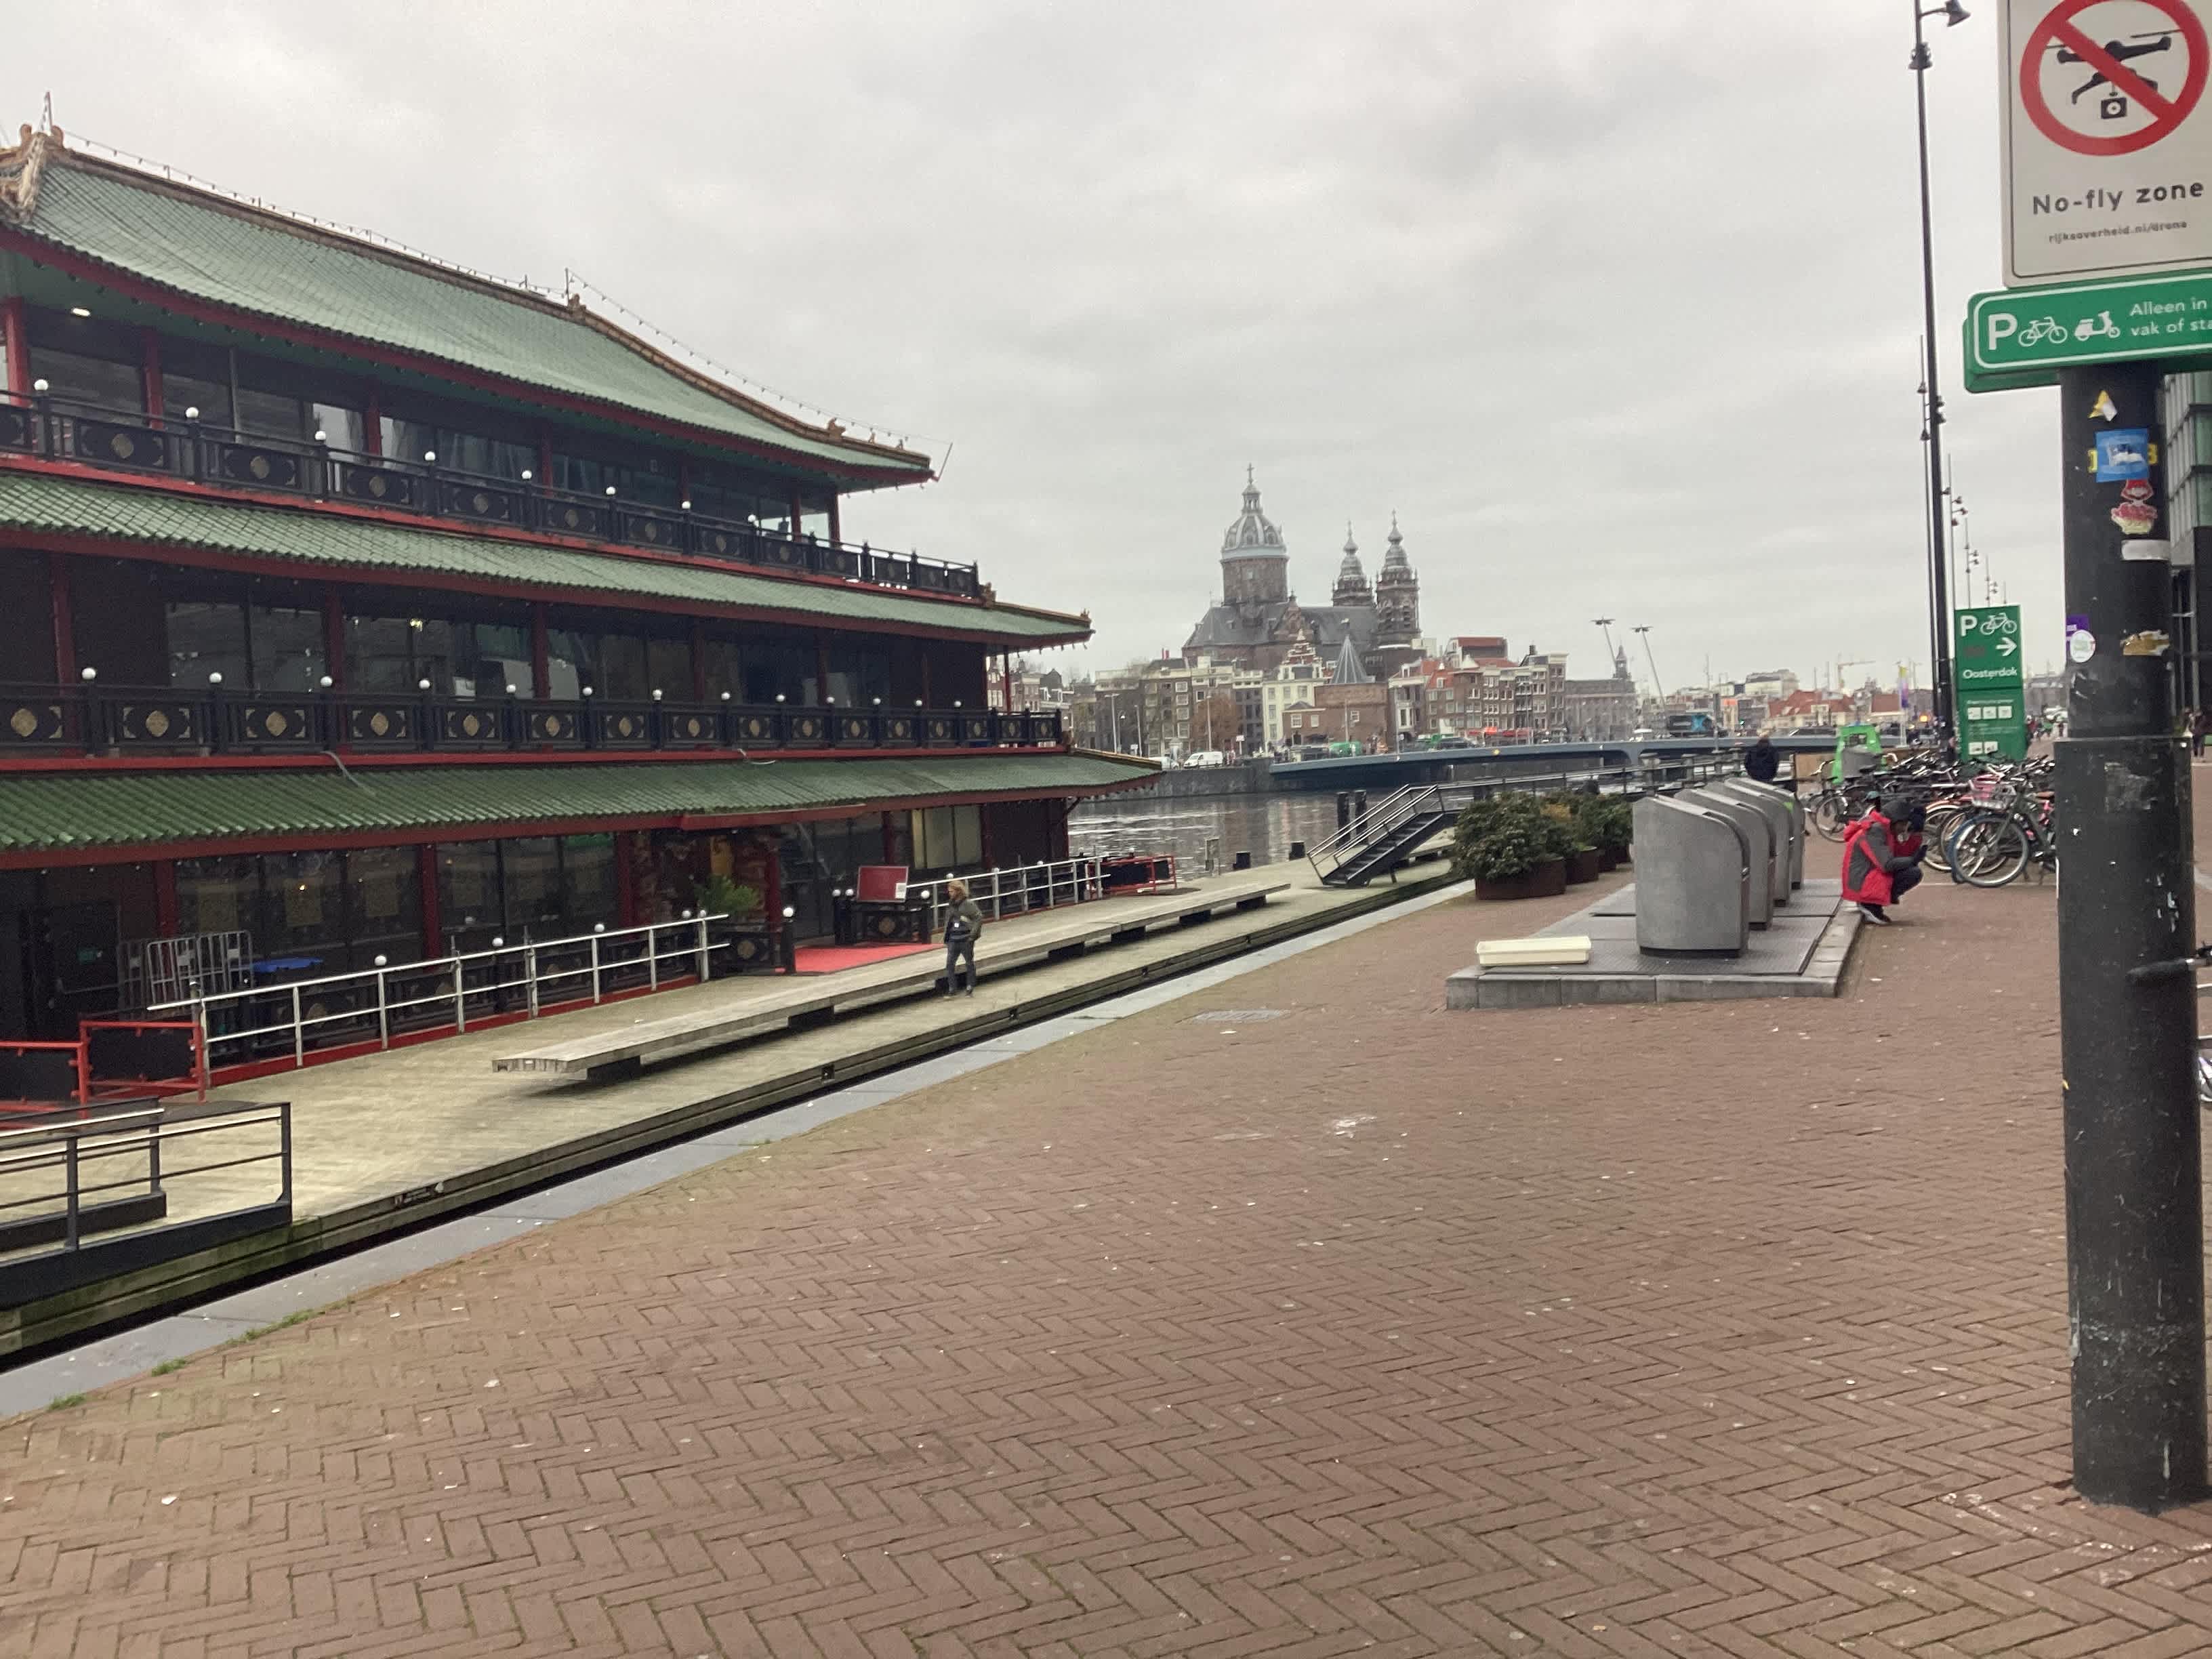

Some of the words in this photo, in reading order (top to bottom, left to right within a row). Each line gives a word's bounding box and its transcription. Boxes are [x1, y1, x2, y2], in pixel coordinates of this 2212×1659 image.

[2033, 188, 2124, 216] No-fly
[2136, 182, 2205, 204] zone
[2129, 301, 2186, 316] Alleen
[2190, 296, 2208, 310] in
[1988, 312, 2018, 350] P
[2131, 320, 2160, 336] vak
[2166, 317, 2186, 333] of
[1961, 615, 1978, 636] P
[1962, 666, 2018, 679] Oosterdok
